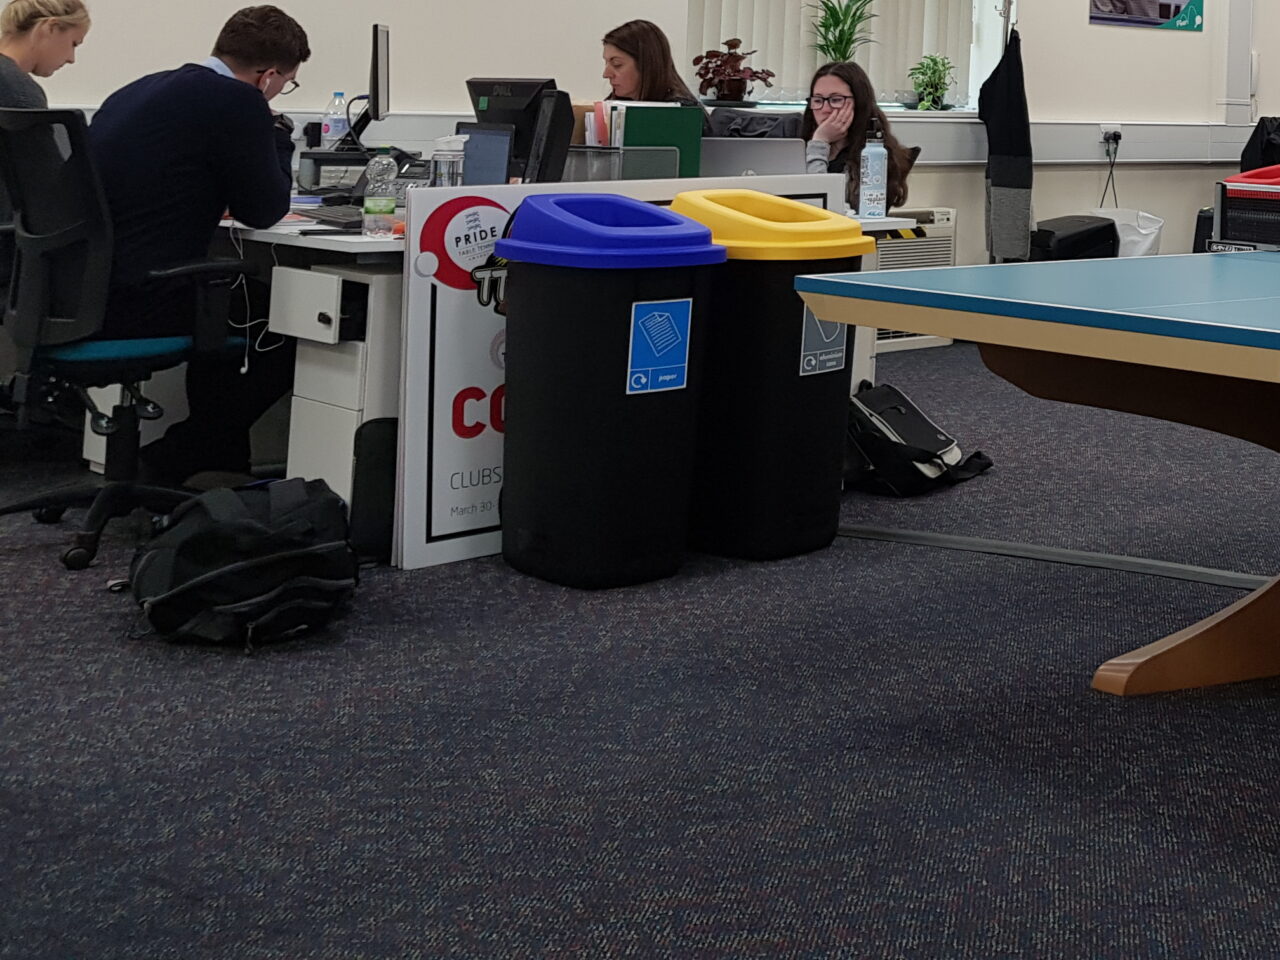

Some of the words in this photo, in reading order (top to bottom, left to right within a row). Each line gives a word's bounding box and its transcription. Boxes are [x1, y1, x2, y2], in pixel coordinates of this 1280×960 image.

[455, 226, 498, 248] PRIDE
[658, 373, 678, 383] paper
[450, 467, 503, 490] CLUBS
[450, 503, 478, 518] March
